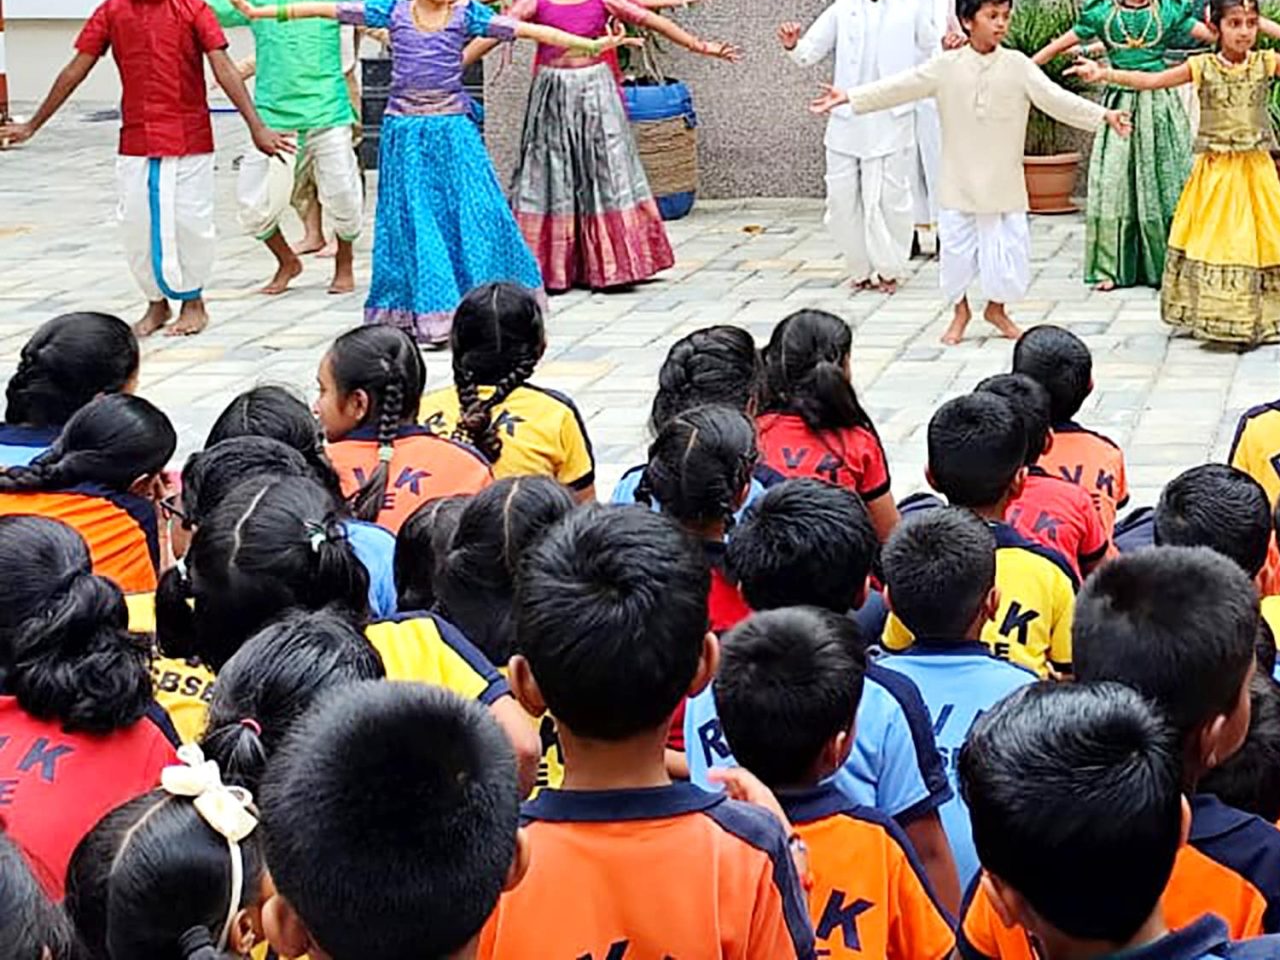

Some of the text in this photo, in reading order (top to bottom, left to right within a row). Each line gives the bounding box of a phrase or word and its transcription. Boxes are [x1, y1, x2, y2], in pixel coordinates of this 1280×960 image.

[394, 466, 432, 496] K
[999, 600, 1040, 646] K
[698, 717, 732, 768] R
[815, 888, 877, 953] K
